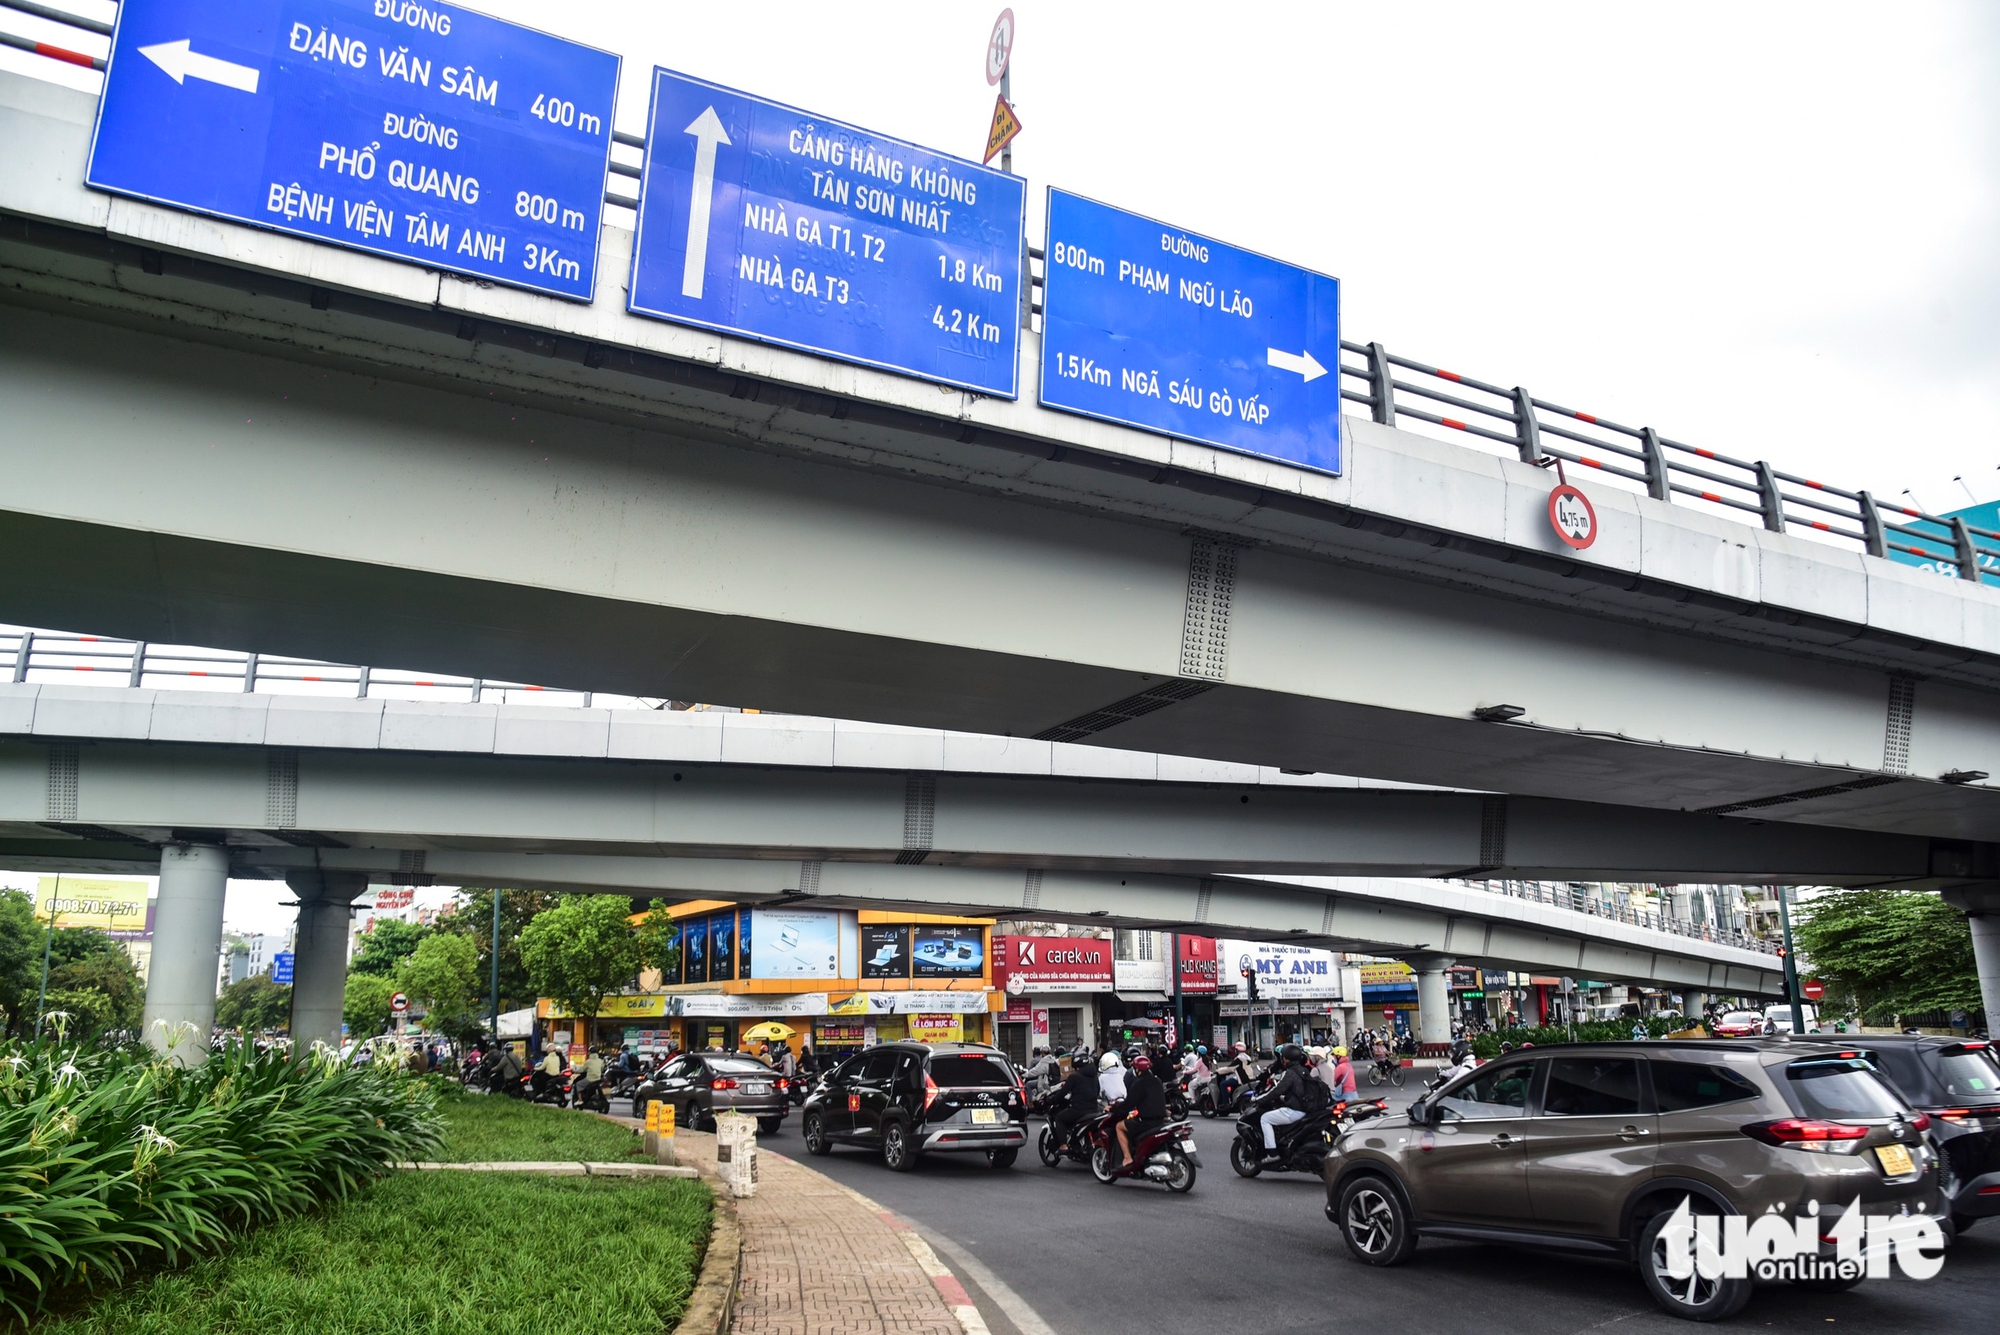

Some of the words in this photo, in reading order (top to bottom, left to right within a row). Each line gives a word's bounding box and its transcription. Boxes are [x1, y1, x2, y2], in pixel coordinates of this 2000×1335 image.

[374, 0, 451, 36] ĐƯỜNG
[289, 23, 367, 69] ĐẶNG
[379, 45, 430, 88] VĂN
[440, 65, 498, 107] SÂM
[383, 111, 458, 150] ĐƯỜNG
[990, 120, 1013, 148] CHẬM
[996, 111, 1005, 126] ĐI
[319, 141, 380, 180] PHỔ
[388, 160, 480, 205] QUANG
[788, 124, 844, 166] CẢNG
[849, 145, 903, 184] HÀNG
[910, 166, 977, 205] KHÔNG
[811, 170, 849, 206] TÂN
[855, 185, 895, 219] SƠN
[901, 201, 952, 235] NHẤT
[266, 182, 334, 226] BỆNH
[343, 200, 392, 240] VIỆN
[405, 212, 449, 251] TÂM
[457, 228, 506, 263] ANH
[744, 202, 788, 238] NHÀ
[795, 216, 822, 245] GA
[862, 233, 886, 263] T2
[523, 243, 580, 281] 3Km
[1161, 233, 1209, 264] ĐƯỜNG
[739, 253, 784, 291] NHÀ
[791, 268, 818, 299] GA
[825, 275, 849, 305] T3
[938, 254, 966, 285] 1,8
[971, 262, 1003, 293] Km
[1054, 242, 1105, 275] 800m
[1119, 260, 1169, 294] PHẠM
[1179, 278, 1215, 307] NGŨ
[1220, 290, 1253, 318] LÃO
[932, 304, 962, 334] 4,2
[967, 314, 1001, 343] Km
[1122, 370, 1161, 398] NGÃ
[1168, 378, 1202, 409] SÁU
[1209, 388, 1232, 416] GÒ
[1238, 394, 1270, 425] VẤP
[1195, 960, 1216, 973] KHANG
[1255, 955, 1283, 974] MỸ
[1290, 960, 1328, 975] ANH
[1259, 945, 1270, 953] NHÀ
[1272, 945, 1288, 954] THUỐC
[1261, 977, 1287, 986] Chuyên
[1289, 976, 1302, 984] Bán
